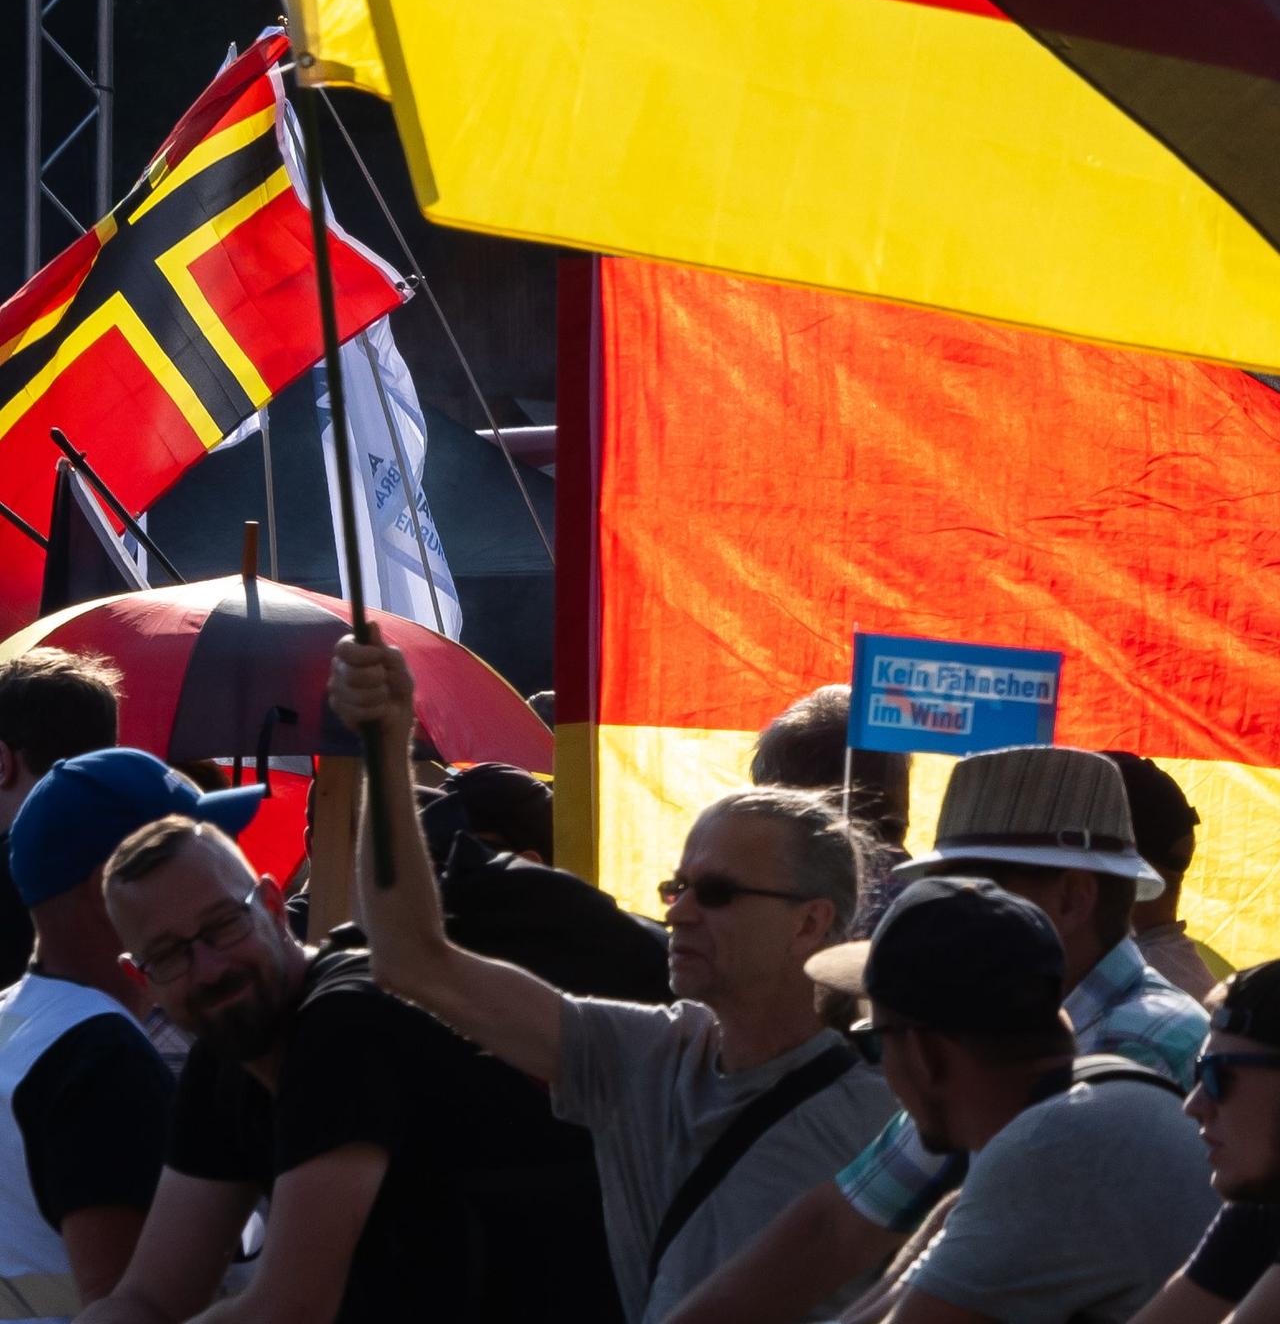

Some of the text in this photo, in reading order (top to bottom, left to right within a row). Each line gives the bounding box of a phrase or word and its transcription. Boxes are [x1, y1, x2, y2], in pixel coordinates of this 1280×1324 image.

[877, 660, 1049, 699] Kein Fähnchen
[872, 697, 968, 732] im Wind
